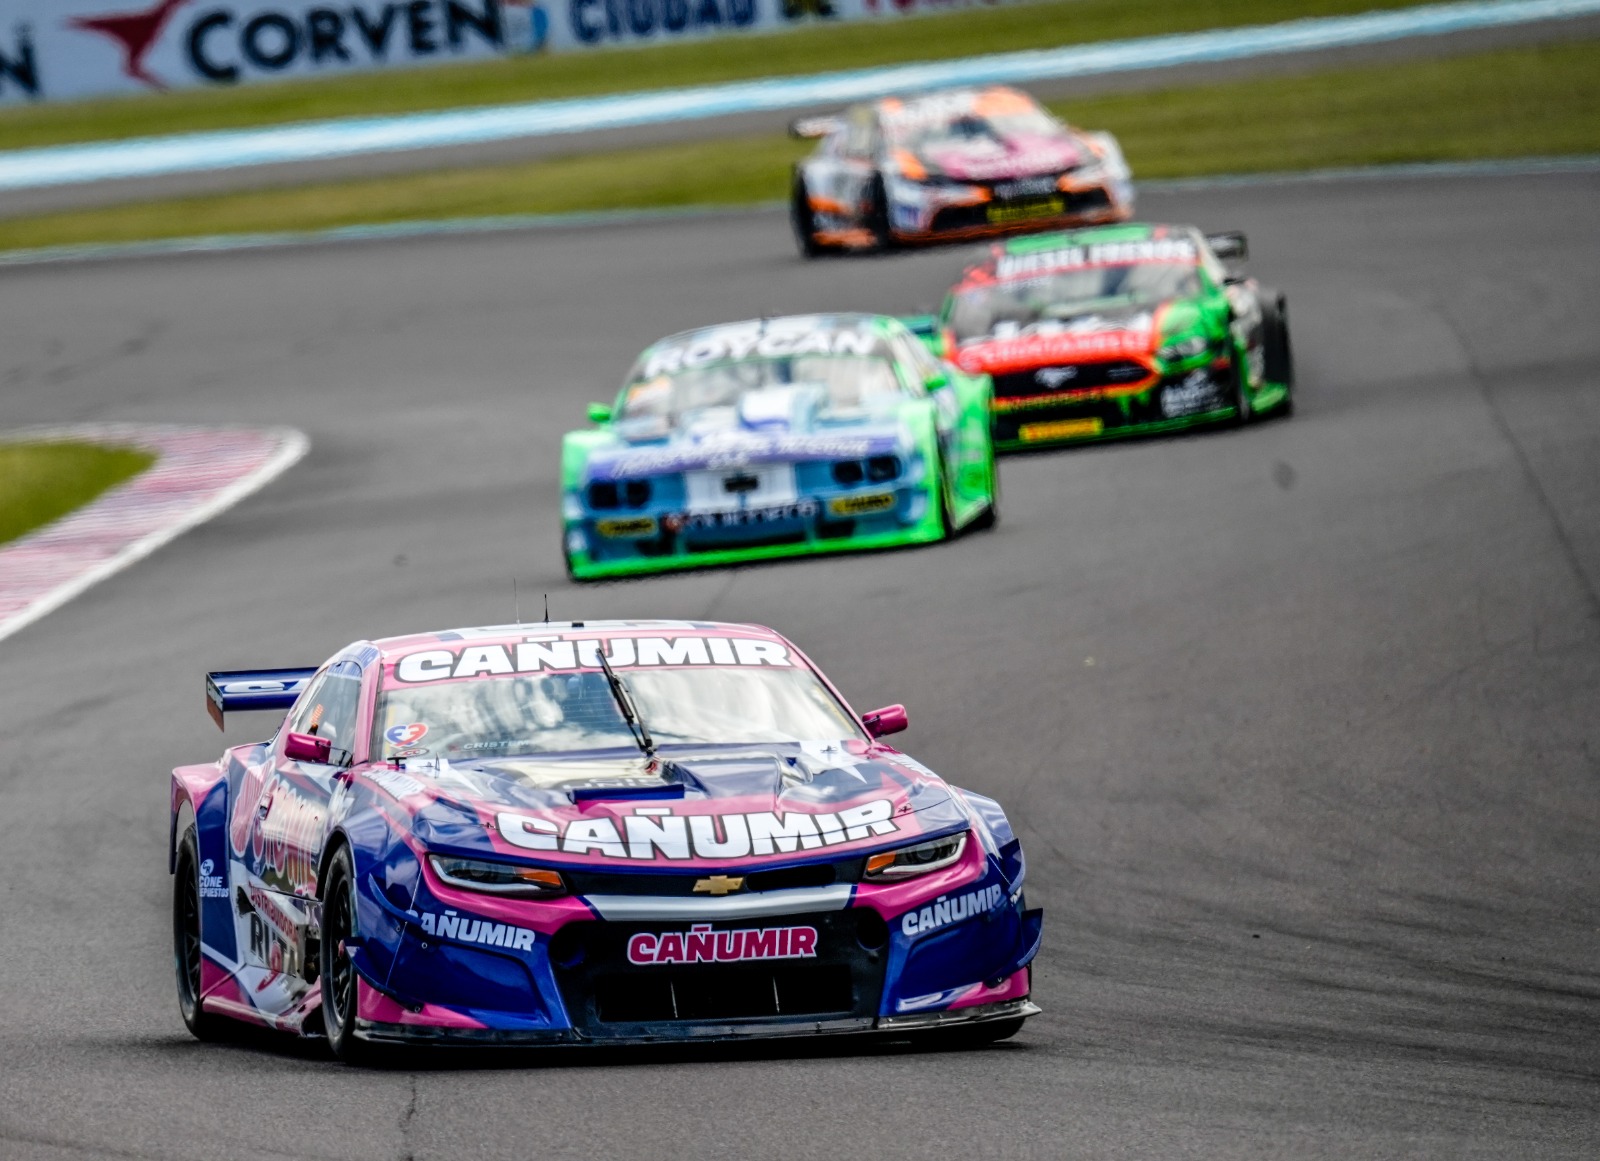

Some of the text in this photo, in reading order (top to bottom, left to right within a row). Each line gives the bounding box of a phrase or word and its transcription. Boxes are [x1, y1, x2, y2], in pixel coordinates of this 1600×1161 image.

[186, 0, 504, 83] CORVEN
[396, 636, 791, 682] CAÑUMIR
[496, 805, 900, 860] CAÑUMIR
[627, 925, 818, 965] CAÑUMIR
